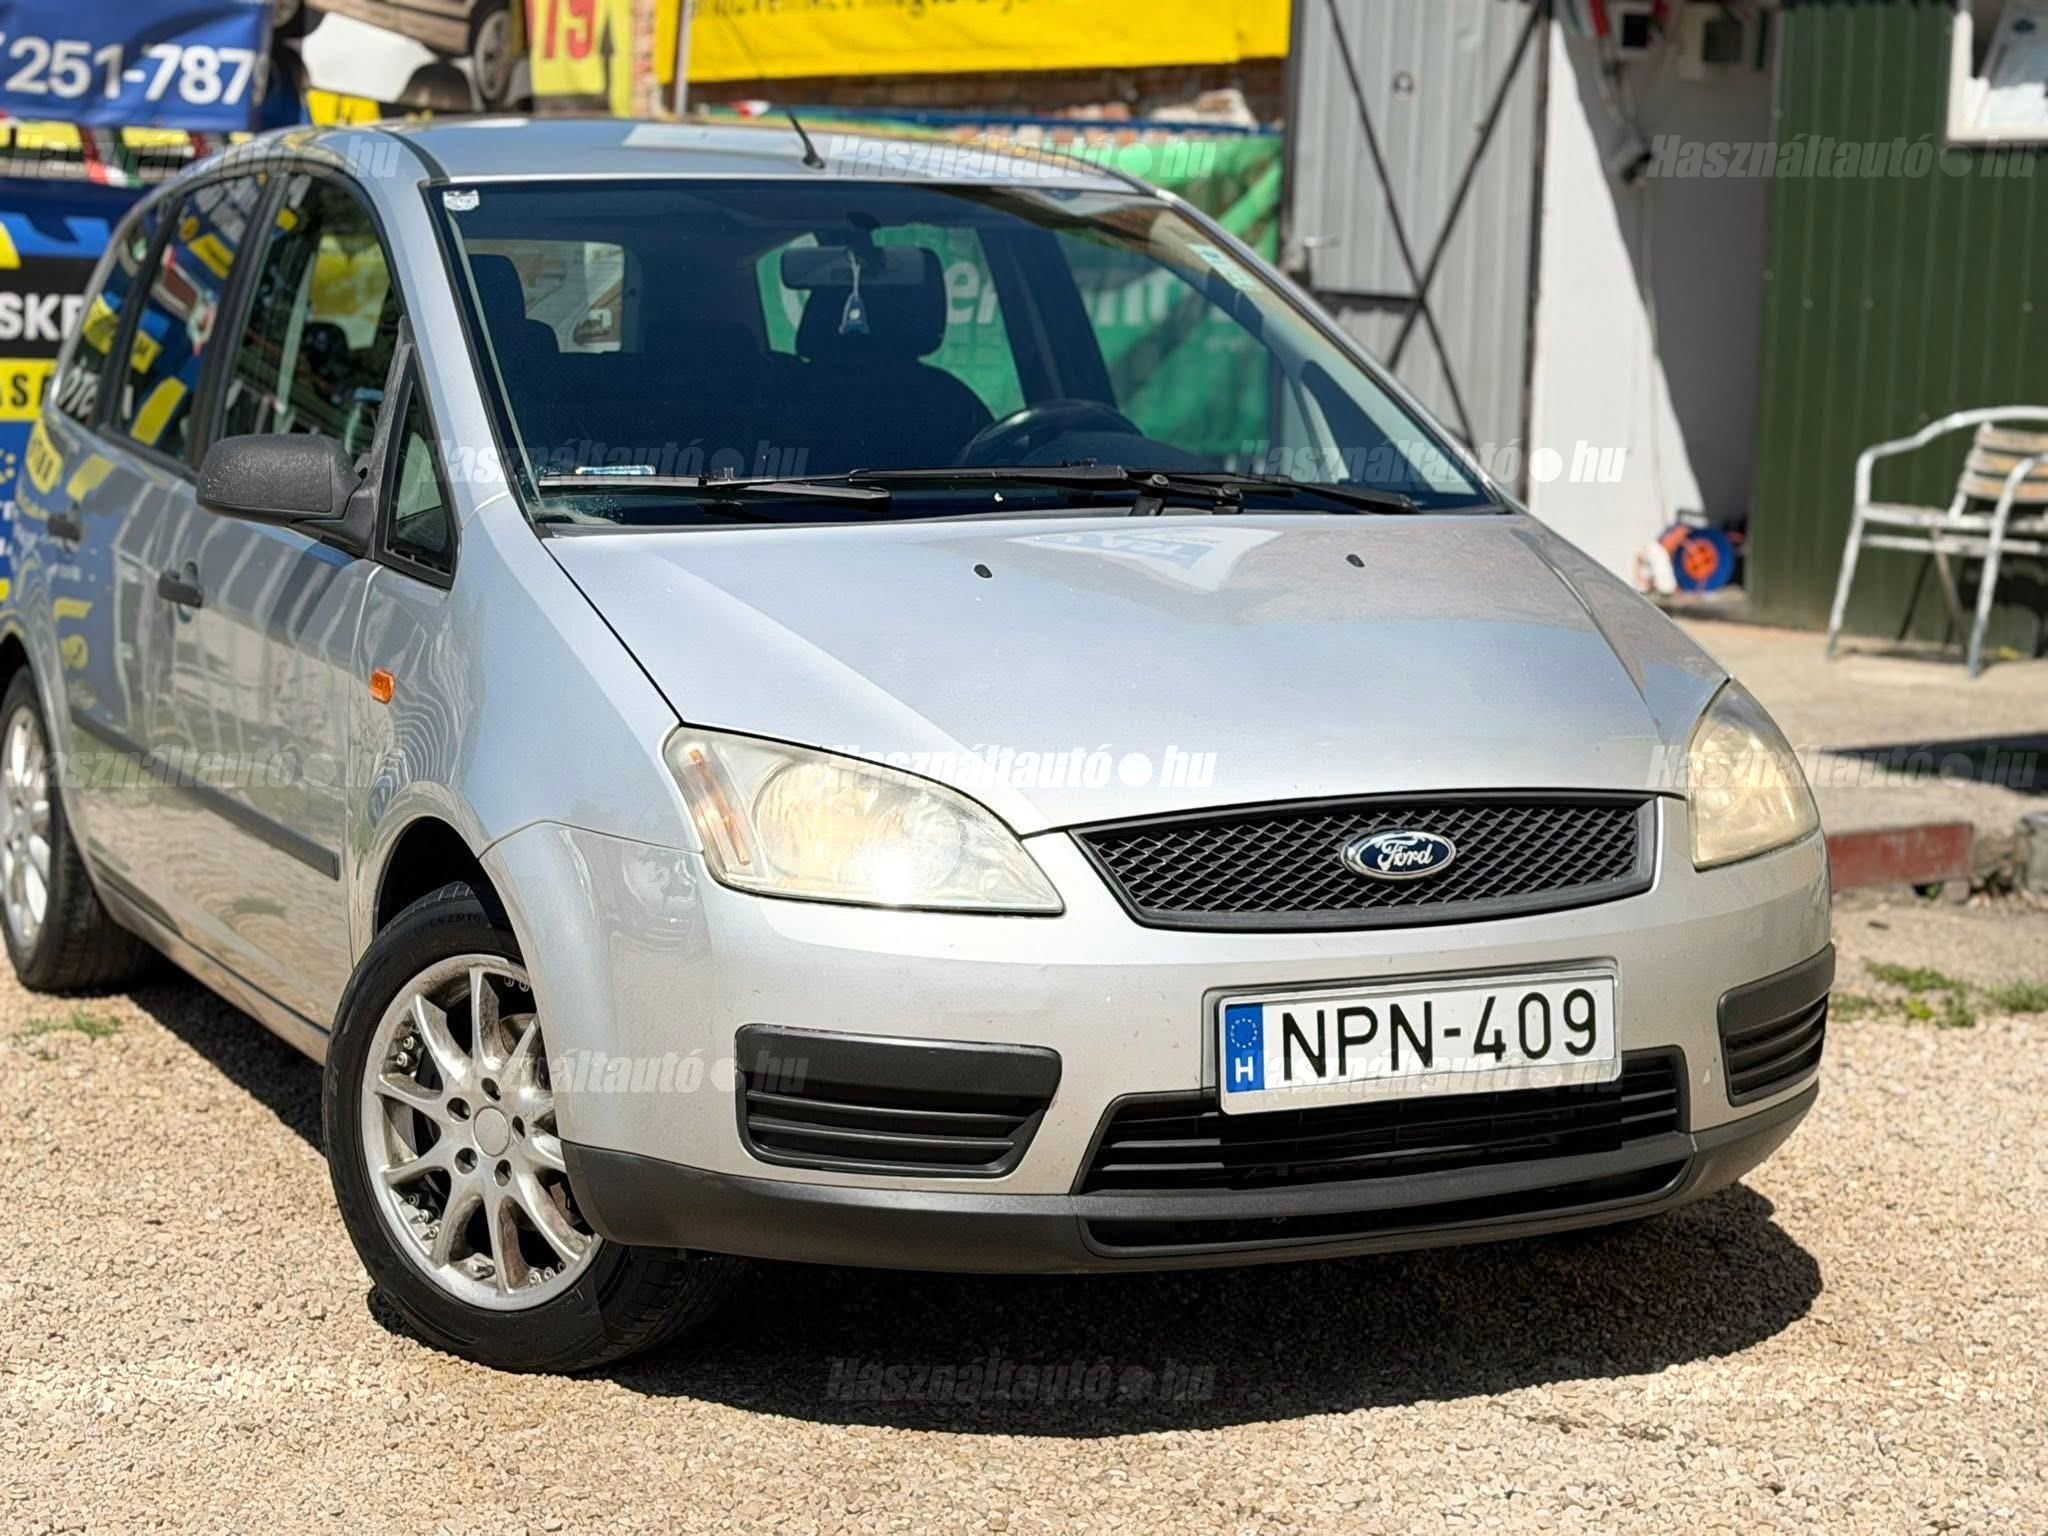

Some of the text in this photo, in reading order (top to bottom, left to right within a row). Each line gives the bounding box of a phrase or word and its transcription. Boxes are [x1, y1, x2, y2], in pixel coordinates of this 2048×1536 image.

[1377, 838, 1434, 872] Ford
[1281, 988, 1597, 1081] NPN-409
[1234, 1056, 1254, 1083] H
